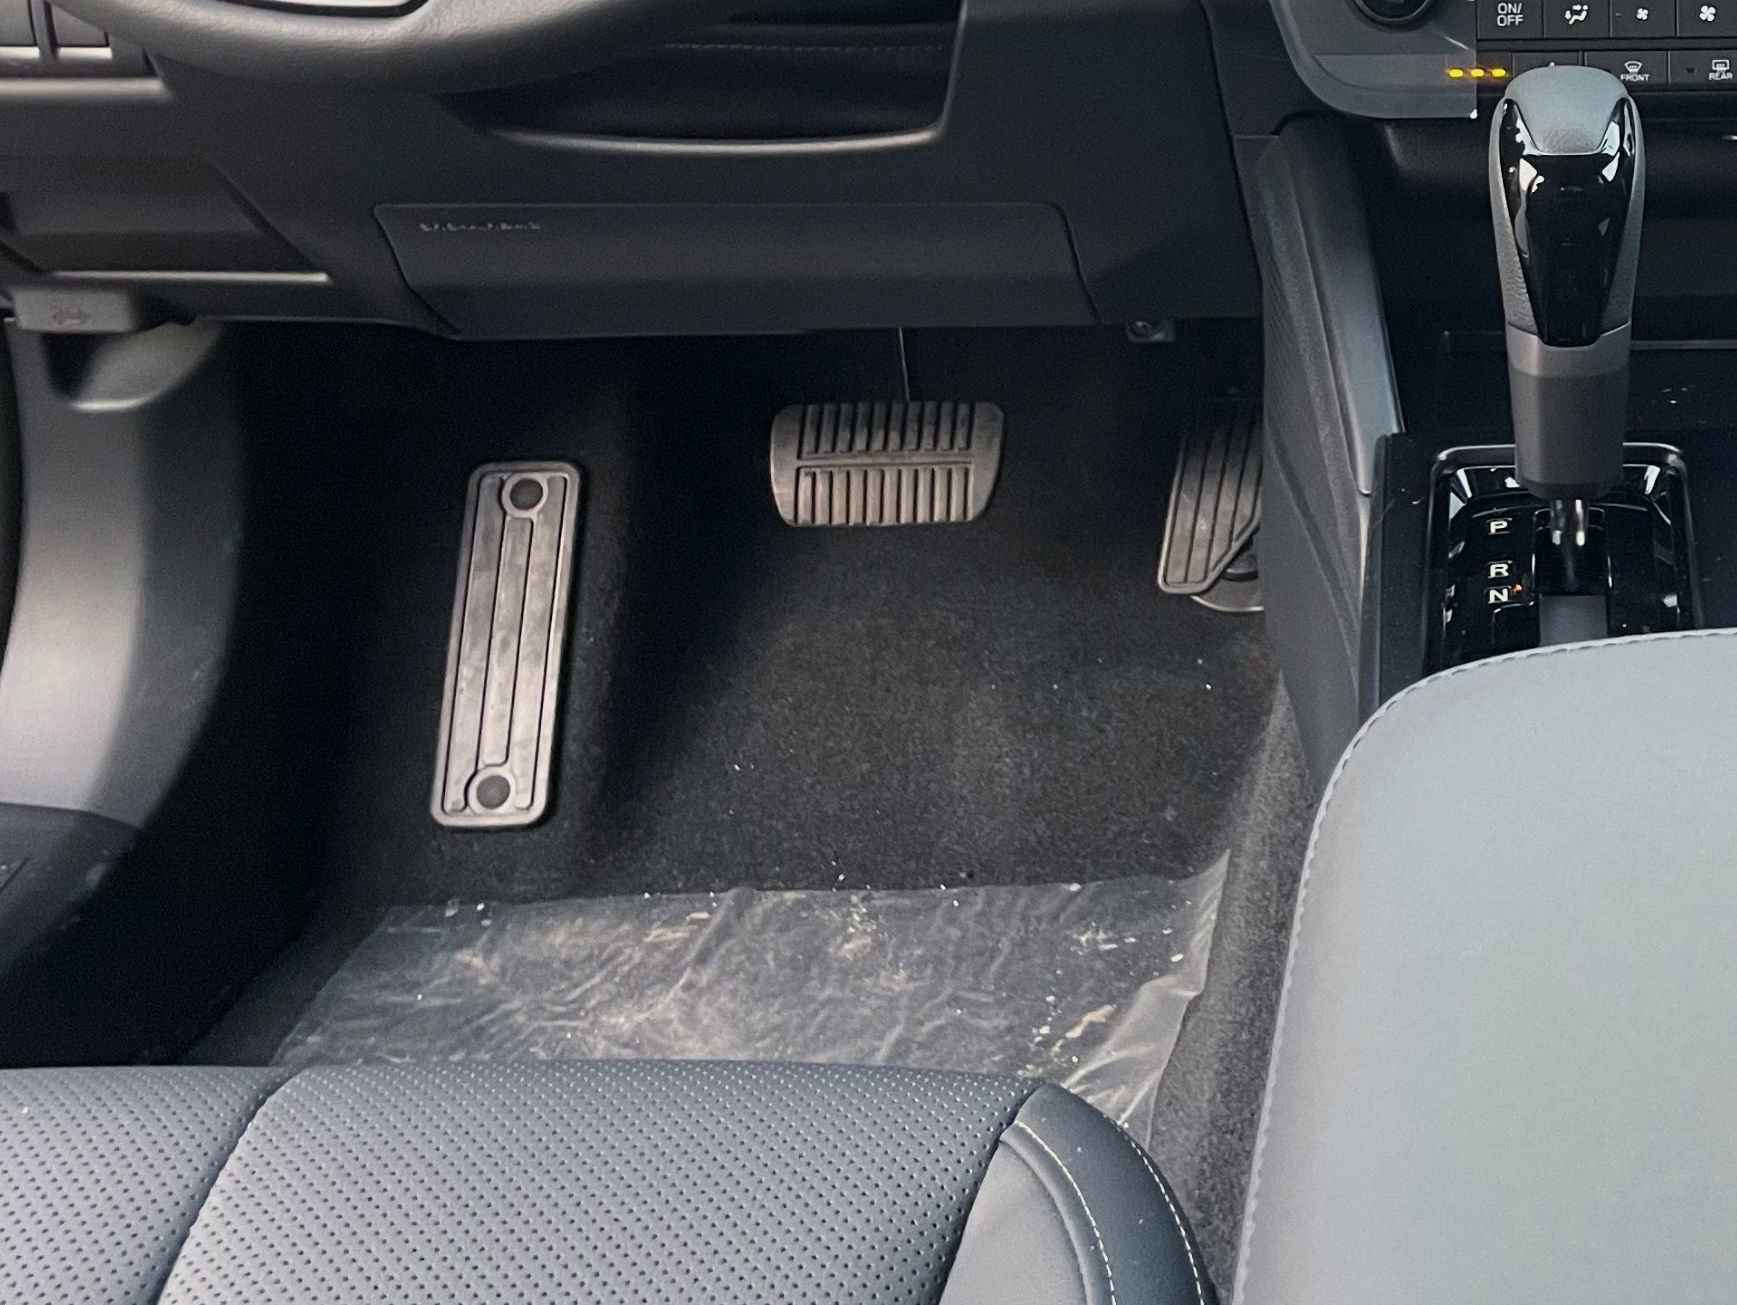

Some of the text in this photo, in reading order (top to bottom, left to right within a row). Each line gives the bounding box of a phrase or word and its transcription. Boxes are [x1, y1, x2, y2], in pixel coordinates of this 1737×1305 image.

[1498, 2, 1522, 14] ON/
[1497, 14, 1524, 27] OFF
[1620, 74, 1649, 82] FRONT
[1708, 72, 1733, 81] REAR
[1490, 520, 1508, 534] P
[1490, 563, 1509, 578] R
[1489, 588, 1508, 603] N
